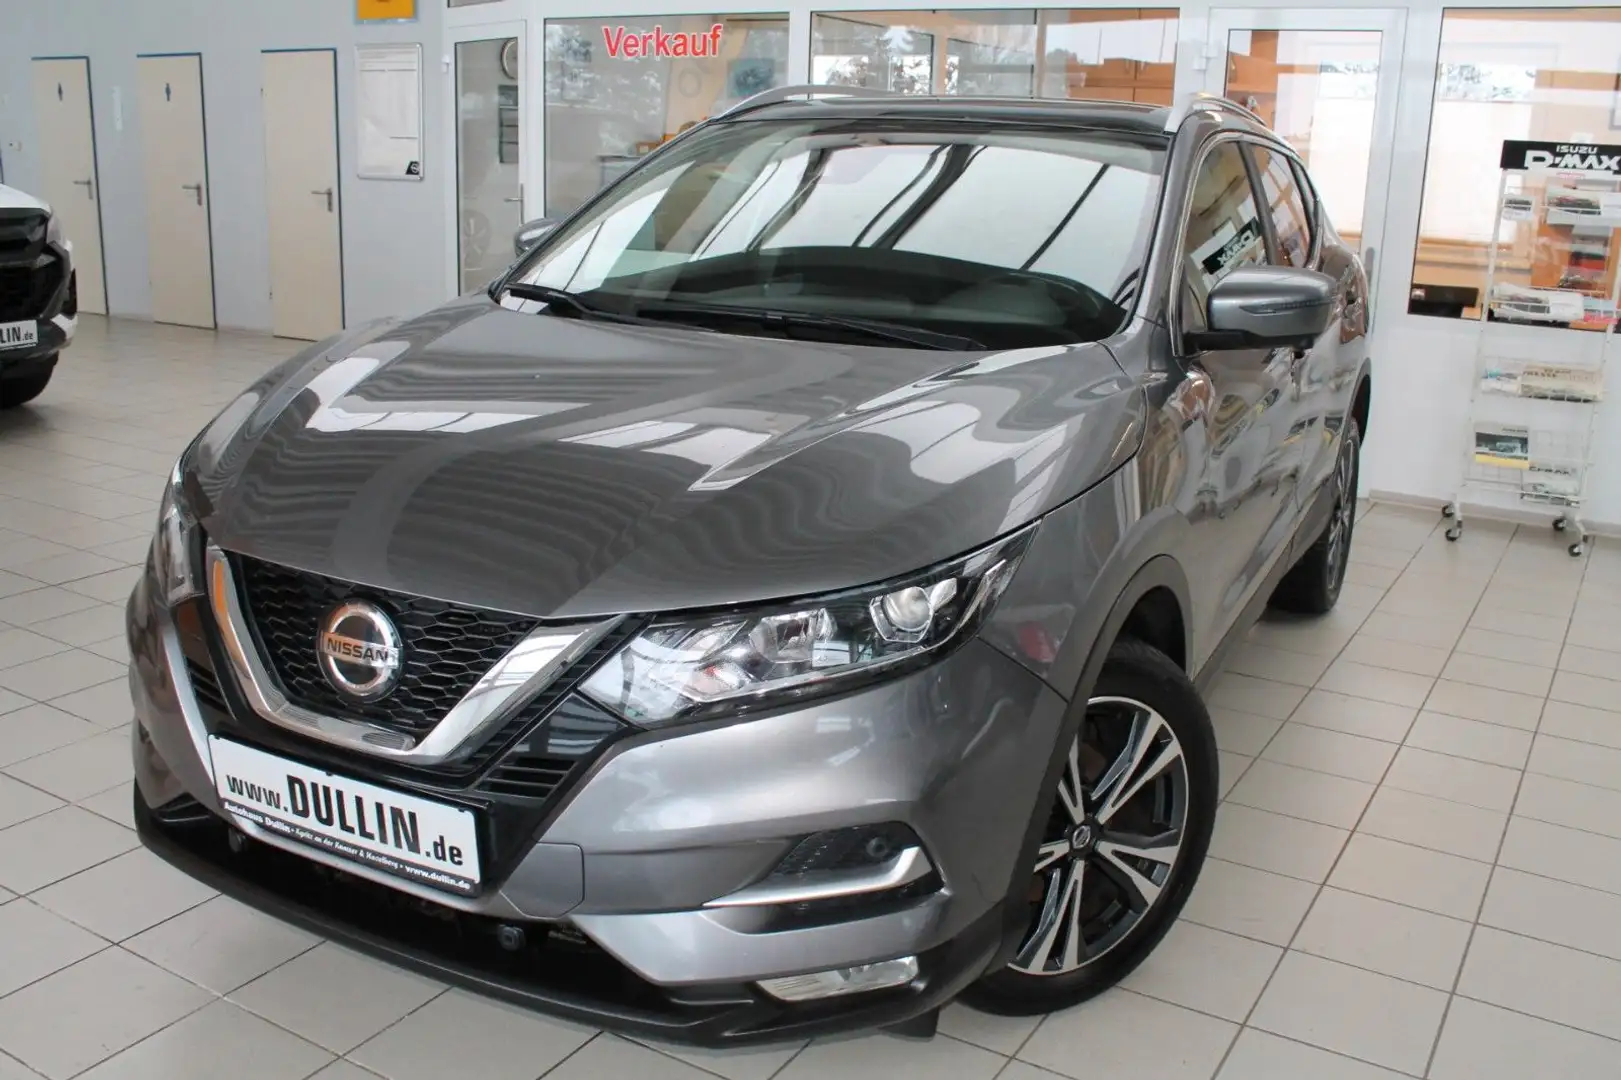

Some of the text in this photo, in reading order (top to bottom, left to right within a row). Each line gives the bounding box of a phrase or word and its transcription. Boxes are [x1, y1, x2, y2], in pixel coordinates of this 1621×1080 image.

[602, 24, 723, 57] Verkauf
[1556, 144, 1599, 154] ISUZU
[327, 638, 389, 662] NISSAN
[226, 774, 464, 867] www.DULLIN.de
[404, 864, 471, 889] www.dullin.de
